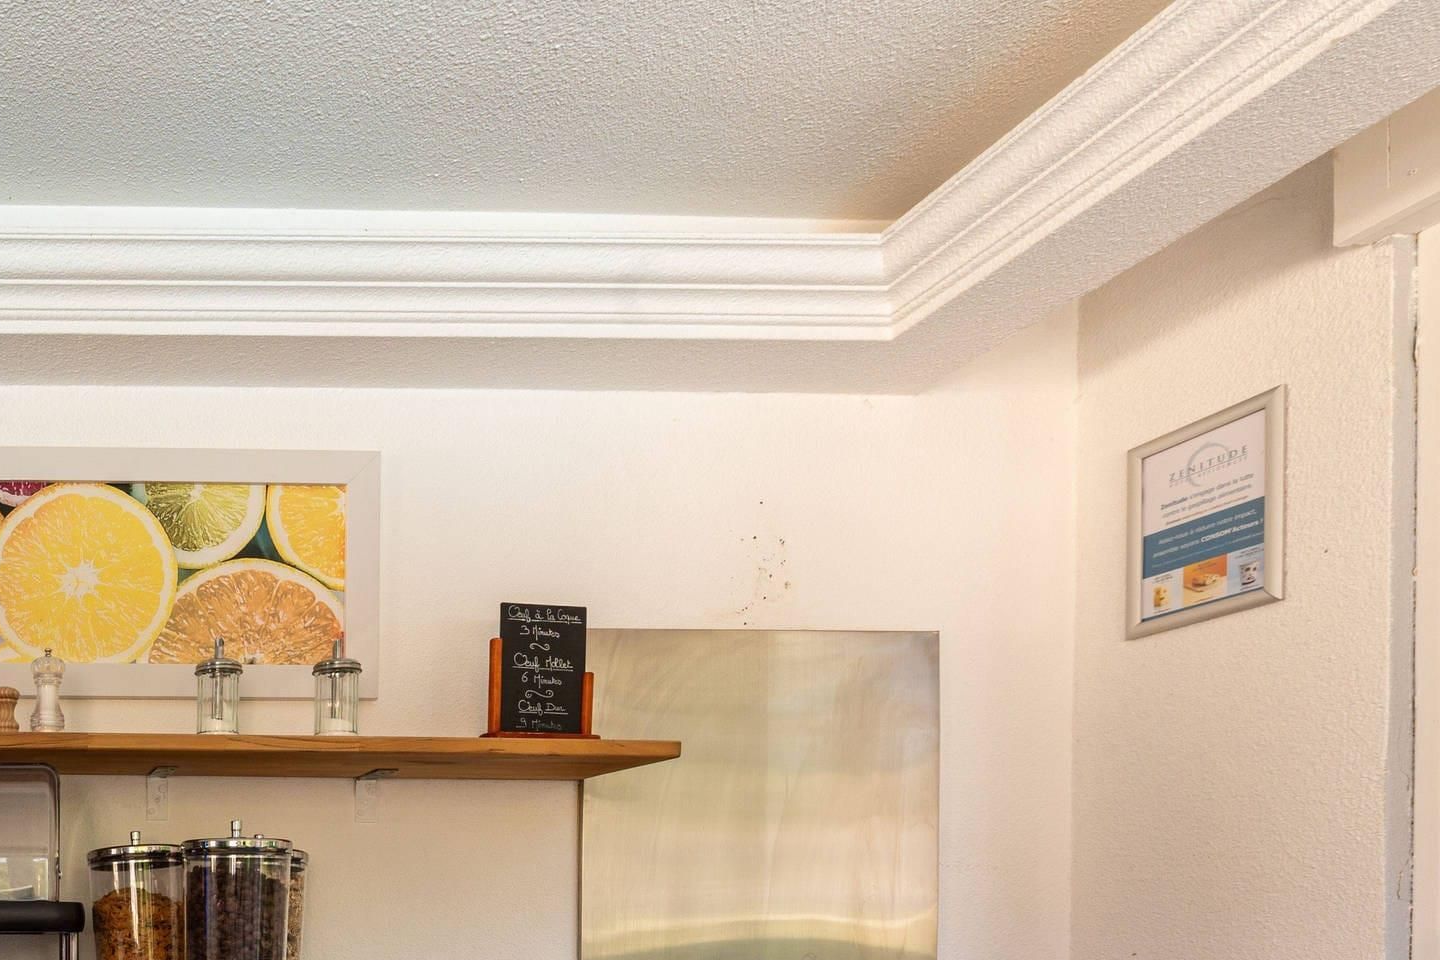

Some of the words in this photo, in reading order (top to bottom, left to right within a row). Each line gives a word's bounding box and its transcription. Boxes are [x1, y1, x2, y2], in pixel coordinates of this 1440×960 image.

[1168, 444, 1248, 481] ZENITUDE
[520, 625, 530, 635] 3
[545, 656, 574, 671] Mollet
[521, 671, 529, 683] 6
